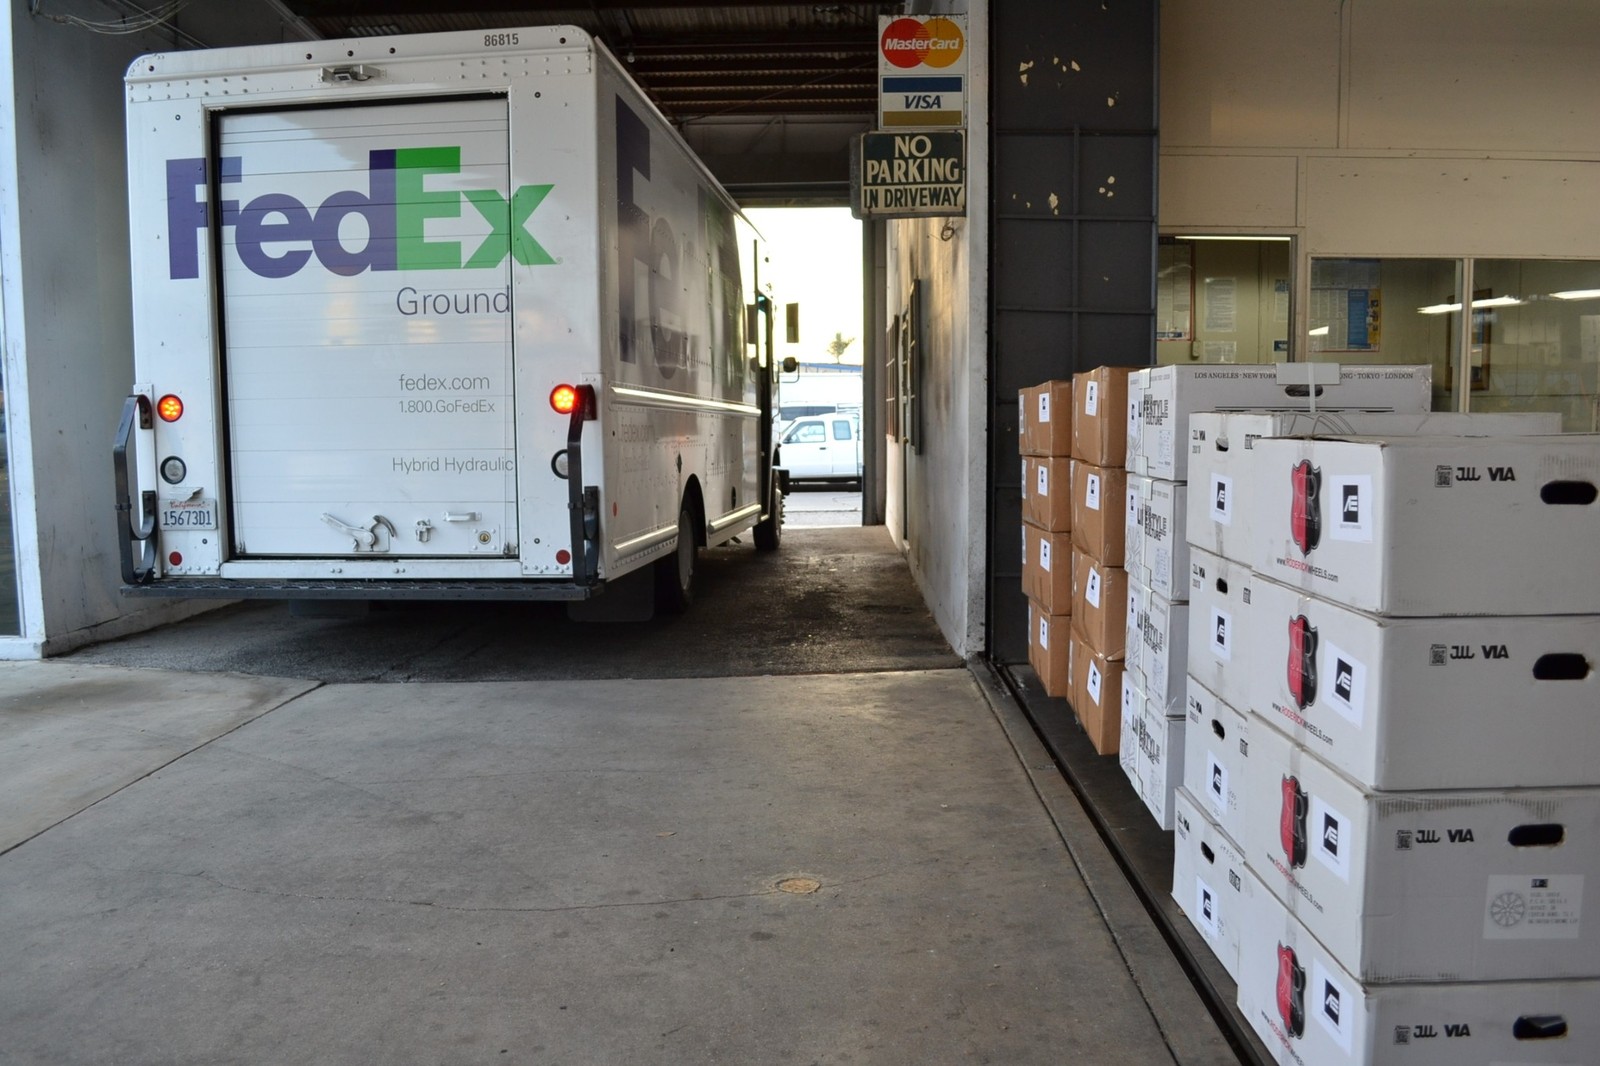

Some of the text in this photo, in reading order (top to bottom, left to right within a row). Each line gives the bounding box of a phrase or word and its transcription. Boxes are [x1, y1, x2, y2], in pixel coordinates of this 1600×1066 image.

[484, 33, 519, 47] 86815
[885, 37, 960, 51] MasterCard
[904, 95, 942, 109] VISA
[894, 135, 932, 158] NO
[866, 158, 960, 184] PARKING
[864, 187, 962, 208] IN DRIVEWAY
[166, 146, 556, 280] FedEx
[397, 284, 511, 316] Ground
[399, 373, 490, 391] fedex.com
[1194, 372, 1209, 380] LOS
[1209, 372, 1239, 380] ANGELES
[1242, 372, 1258, 380] NEW
[1357, 372, 1380, 380] TOKYO
[1385, 372, 1414, 380] LONDON
[399, 399, 495, 413] 1.800.GoFedEx
[392, 457, 514, 475] Hybrid Hydraulic
[1487, 466, 1516, 481] VIA
[163, 510, 212, 526] 15673D1
[1481, 644, 1510, 659] VIA
[1447, 828, 1475, 843] VIA
[1444, 1023, 1471, 1038] VIA
